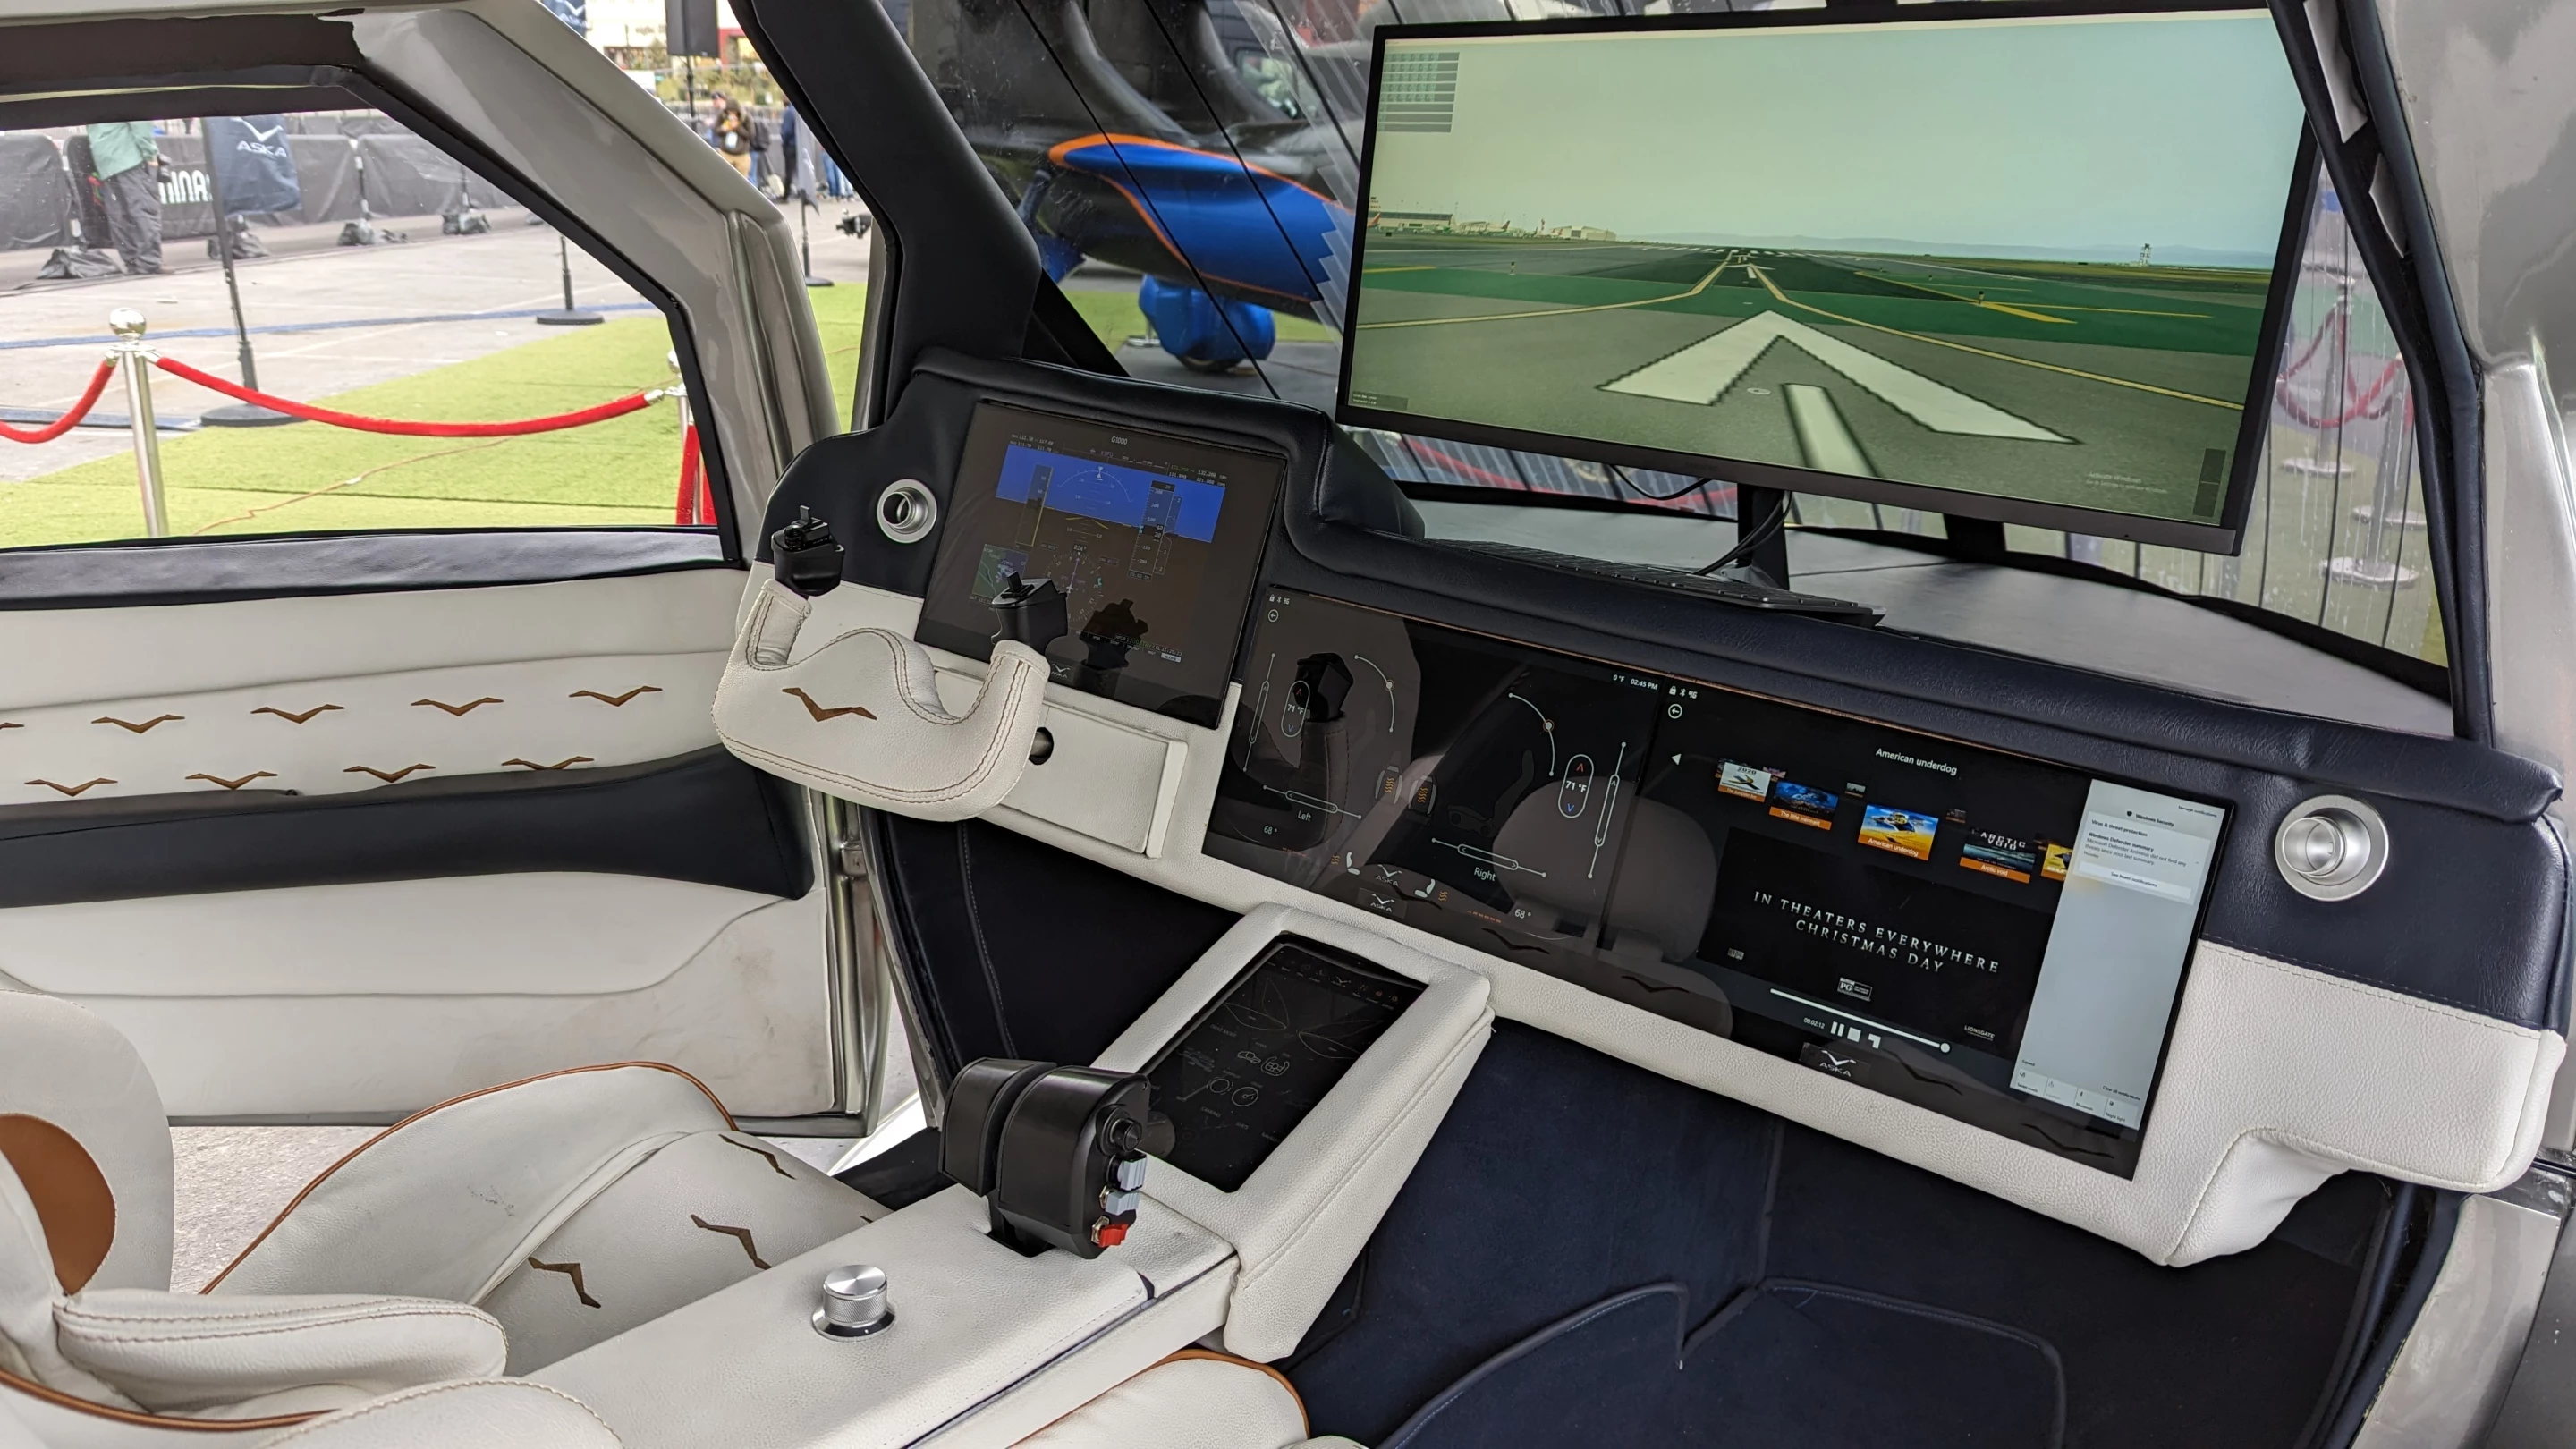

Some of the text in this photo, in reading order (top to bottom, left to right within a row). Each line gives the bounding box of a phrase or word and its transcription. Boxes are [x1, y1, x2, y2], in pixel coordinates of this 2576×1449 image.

[236, 140, 288, 160] ASKA
[1111, 436, 1128, 446] G1000
[1631, 678, 1647, 689] 02:45
[1647, 681, 1659, 691] PM
[1287, 704, 1296, 714] 71
[1875, 747, 1958, 776] American underdog
[1736, 766, 1758, 776] 2020
[1565, 780, 1576, 791] 71
[1297, 810, 1312, 822] Left
[1781, 810, 1790, 818] The
[2135, 813, 2174, 828] Windows Security
[2091, 818, 2103, 827] Virus
[2108, 824, 2123, 832] threat
[2123, 826, 2148, 837] protection
[1868, 836, 1919, 857] American underdog
[1980, 831, 2026, 848] ARCTIC
[2088, 832, 2154, 852] Windows Defender summary
[2085, 843, 2100, 852] threats
[2101, 848, 2113, 856] since
[2113, 852, 2123, 860] your
[2124, 852, 2132, 860] last
[2087, 837, 2107, 848] Microsoft
[2108, 843, 2129, 852] Defender
[2129, 847, 2149, 858] Antivirus
[1474, 867, 1497, 883] Right
[1980, 863, 1996, 874] Arctic
[1996, 867, 2009, 877] void
[1370, 902, 1394, 913] ASKA
[1753, 891, 2000, 973] IN THEATERS EVERYWHERE
[1795, 919, 1945, 973] CHRISTMAS DAY
[1839, 981, 1853, 993] PG
[1803, 1016, 1826, 1030] 00:02:12
[1964, 1024, 1996, 1038] LIONSGATE
[1819, 1061, 1852, 1077] ASKA
